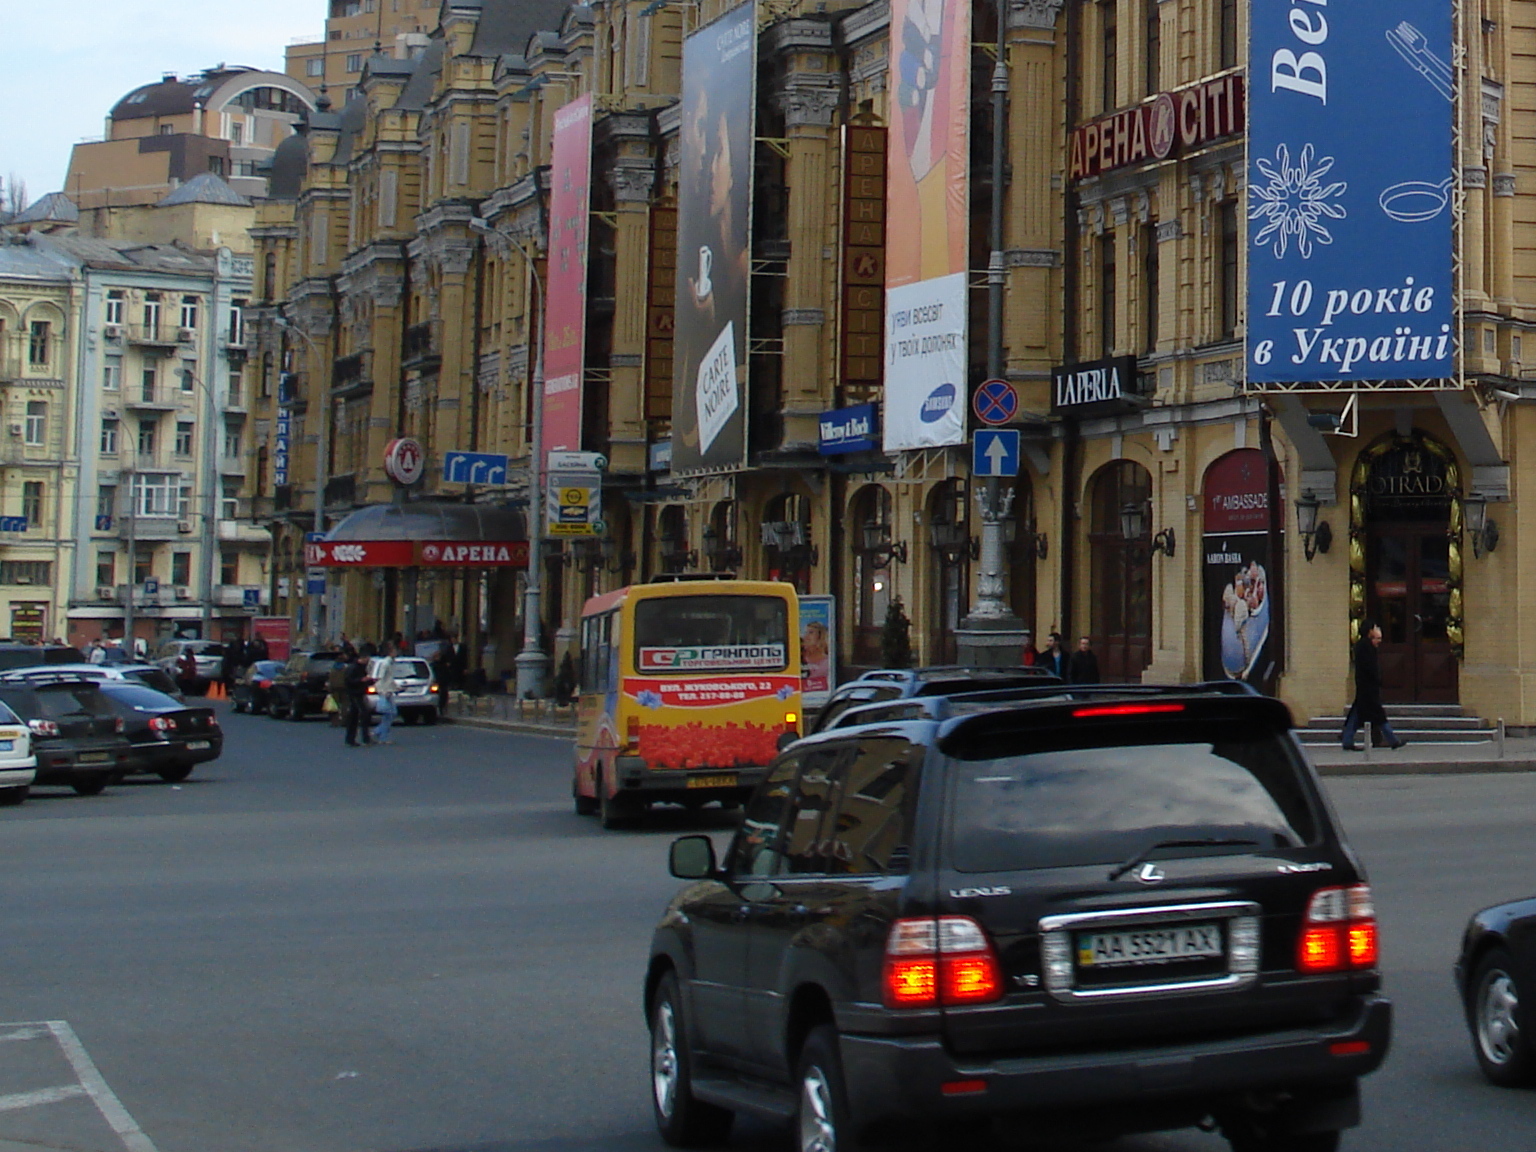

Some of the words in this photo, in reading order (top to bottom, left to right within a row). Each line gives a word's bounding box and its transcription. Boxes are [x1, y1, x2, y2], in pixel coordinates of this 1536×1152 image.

[1070, 106, 1147, 179] АРЕНА
[1265, 280, 1313, 317] 10
[1320, 276, 1434, 326] років
[703, 345, 728, 395] CARTE
[1253, 338, 1274, 365] в
[1291, 323, 1451, 373] Україні
[704, 372, 731, 422] NOIRE
[1371, 475, 1444, 494] OTRAD
[442, 545, 510, 562] АРЕНА
[949, 885, 1012, 899] LEXUS
